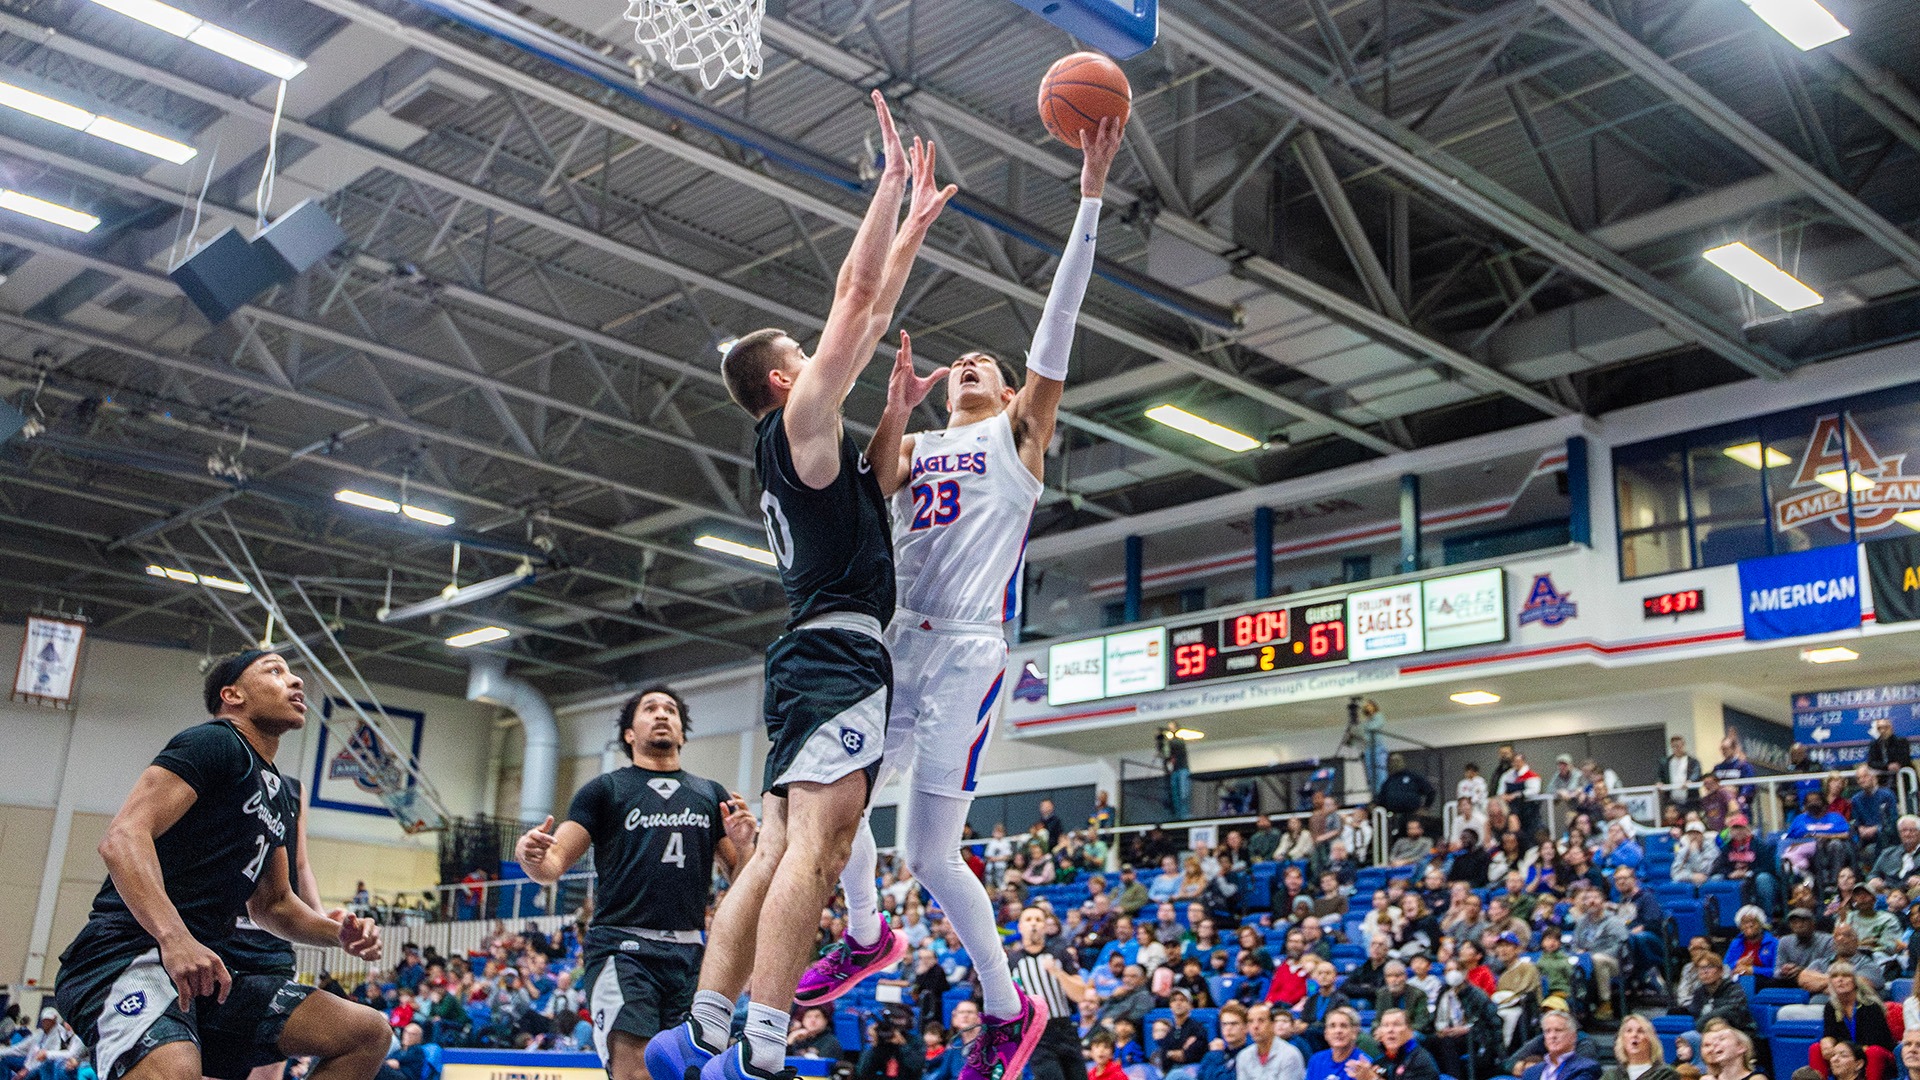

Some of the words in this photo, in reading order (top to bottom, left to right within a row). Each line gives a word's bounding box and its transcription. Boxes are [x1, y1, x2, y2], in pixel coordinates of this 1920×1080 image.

[911, 451, 987, 480] AGLES
[910, 480, 961, 532] 23
[1749, 575, 1856, 614] AMERICAN
[1235, 609, 1288, 647] 8:04
[1357, 608, 1414, 635] EAGLES
[1309, 621, 1345, 657] 67
[1175, 643, 1207, 677] 53
[1260, 646, 1276, 671] 2
[1881, 684, 1920, 702] AREN
[624, 807, 711, 831] Crusaders
[661, 832, 686, 869] 4
